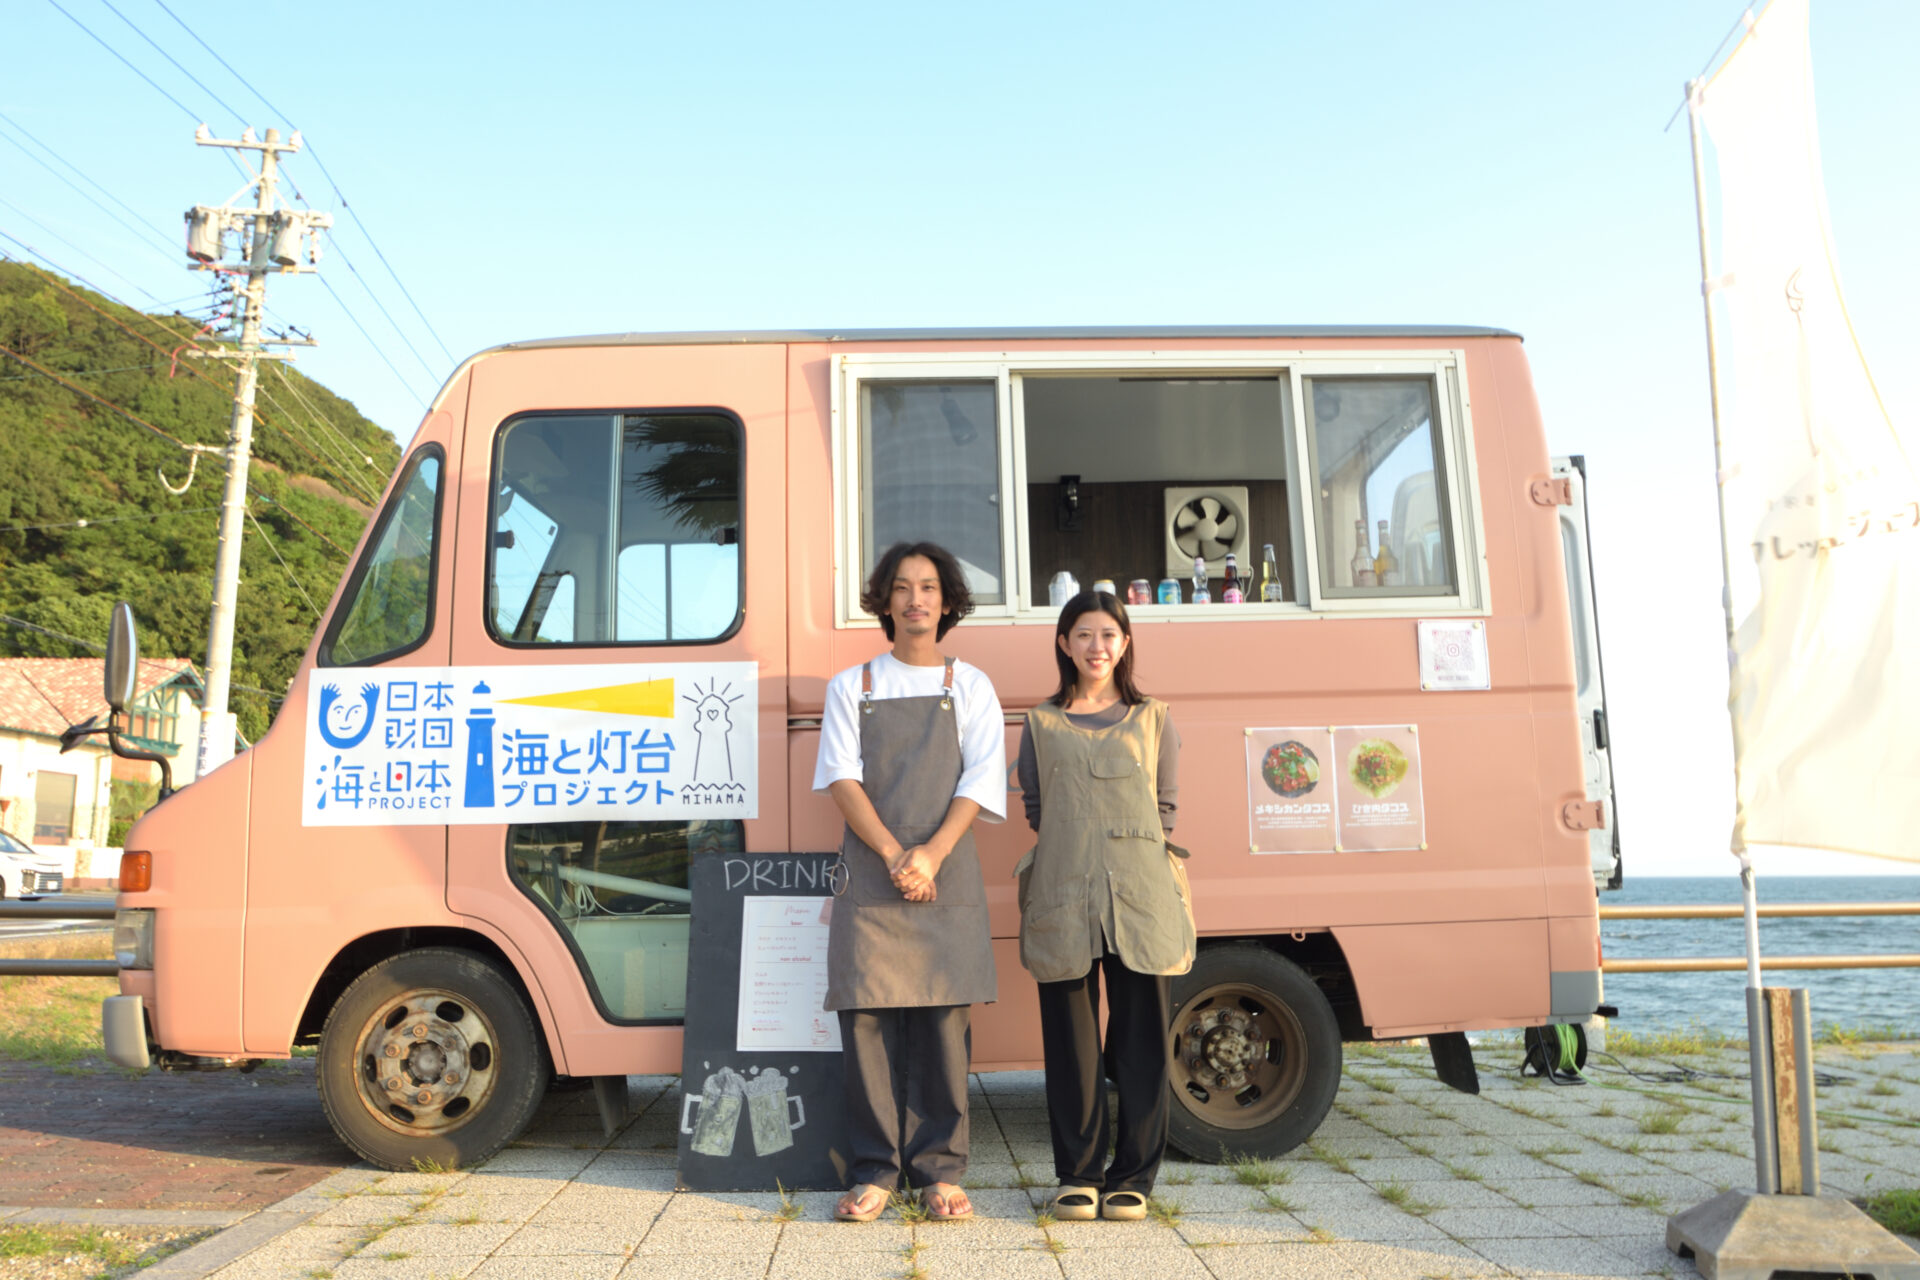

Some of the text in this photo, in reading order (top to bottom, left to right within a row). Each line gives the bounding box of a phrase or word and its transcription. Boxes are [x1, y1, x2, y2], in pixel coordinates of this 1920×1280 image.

[386, 681, 454, 711] 日本
[385, 718, 453, 749] 財団
[502, 728, 676, 776] 海と灯台
[368, 796, 452, 809] PROJECT
[502, 780, 675, 807] プロジェクト
[682, 793, 745, 805] MIHAMA
[1255, 803, 1331, 815] メキシカンタコス
